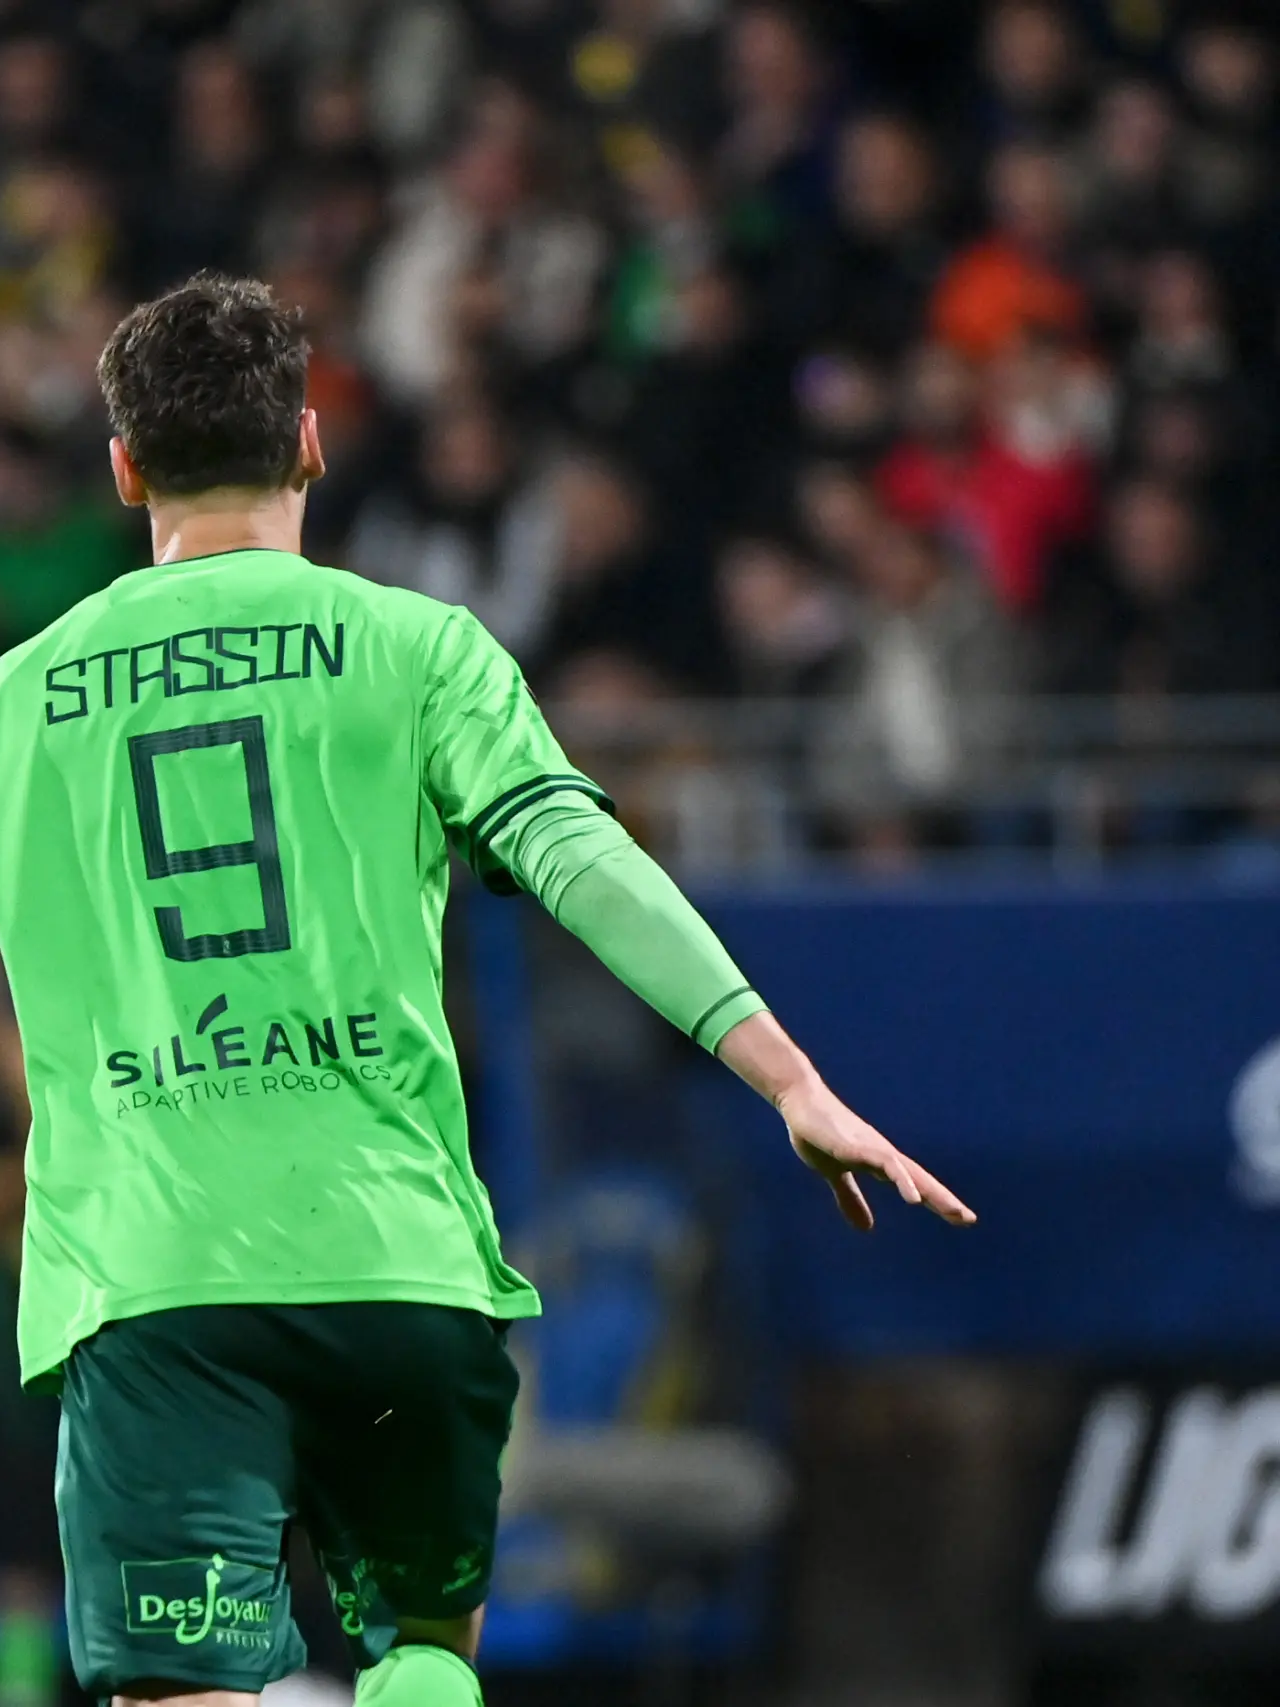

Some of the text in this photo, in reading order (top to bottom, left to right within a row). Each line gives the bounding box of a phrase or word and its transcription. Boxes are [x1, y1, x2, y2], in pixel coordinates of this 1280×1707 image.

[45, 622, 345, 726] STASSIN
[126, 714, 292, 963] 9
[116, 1063, 392, 1119] ADAPTIVE ROBOICS
